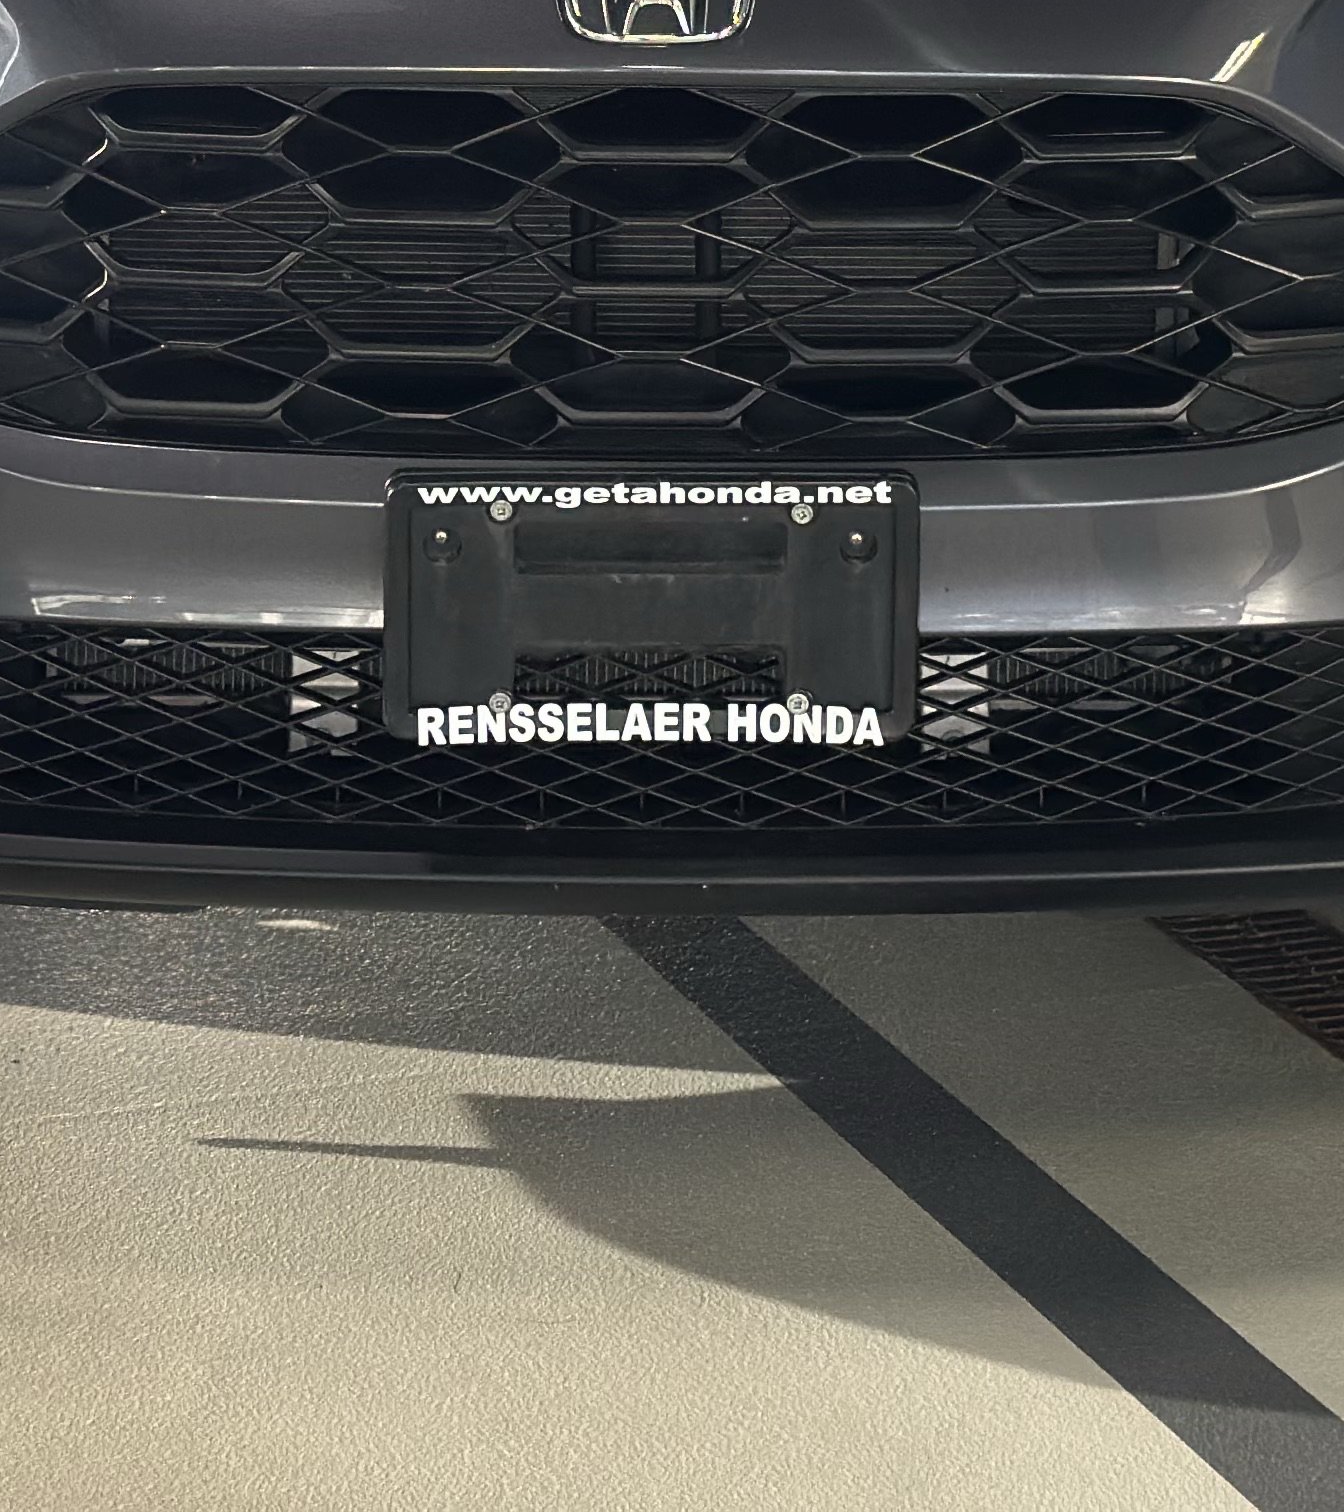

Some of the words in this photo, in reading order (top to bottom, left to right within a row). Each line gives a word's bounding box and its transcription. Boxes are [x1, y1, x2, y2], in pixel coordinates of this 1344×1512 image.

[417, 480, 892, 509] www.getahonda.net
[417, 702, 712, 747] RENSSELAER
[727, 702, 885, 747] HONDA
